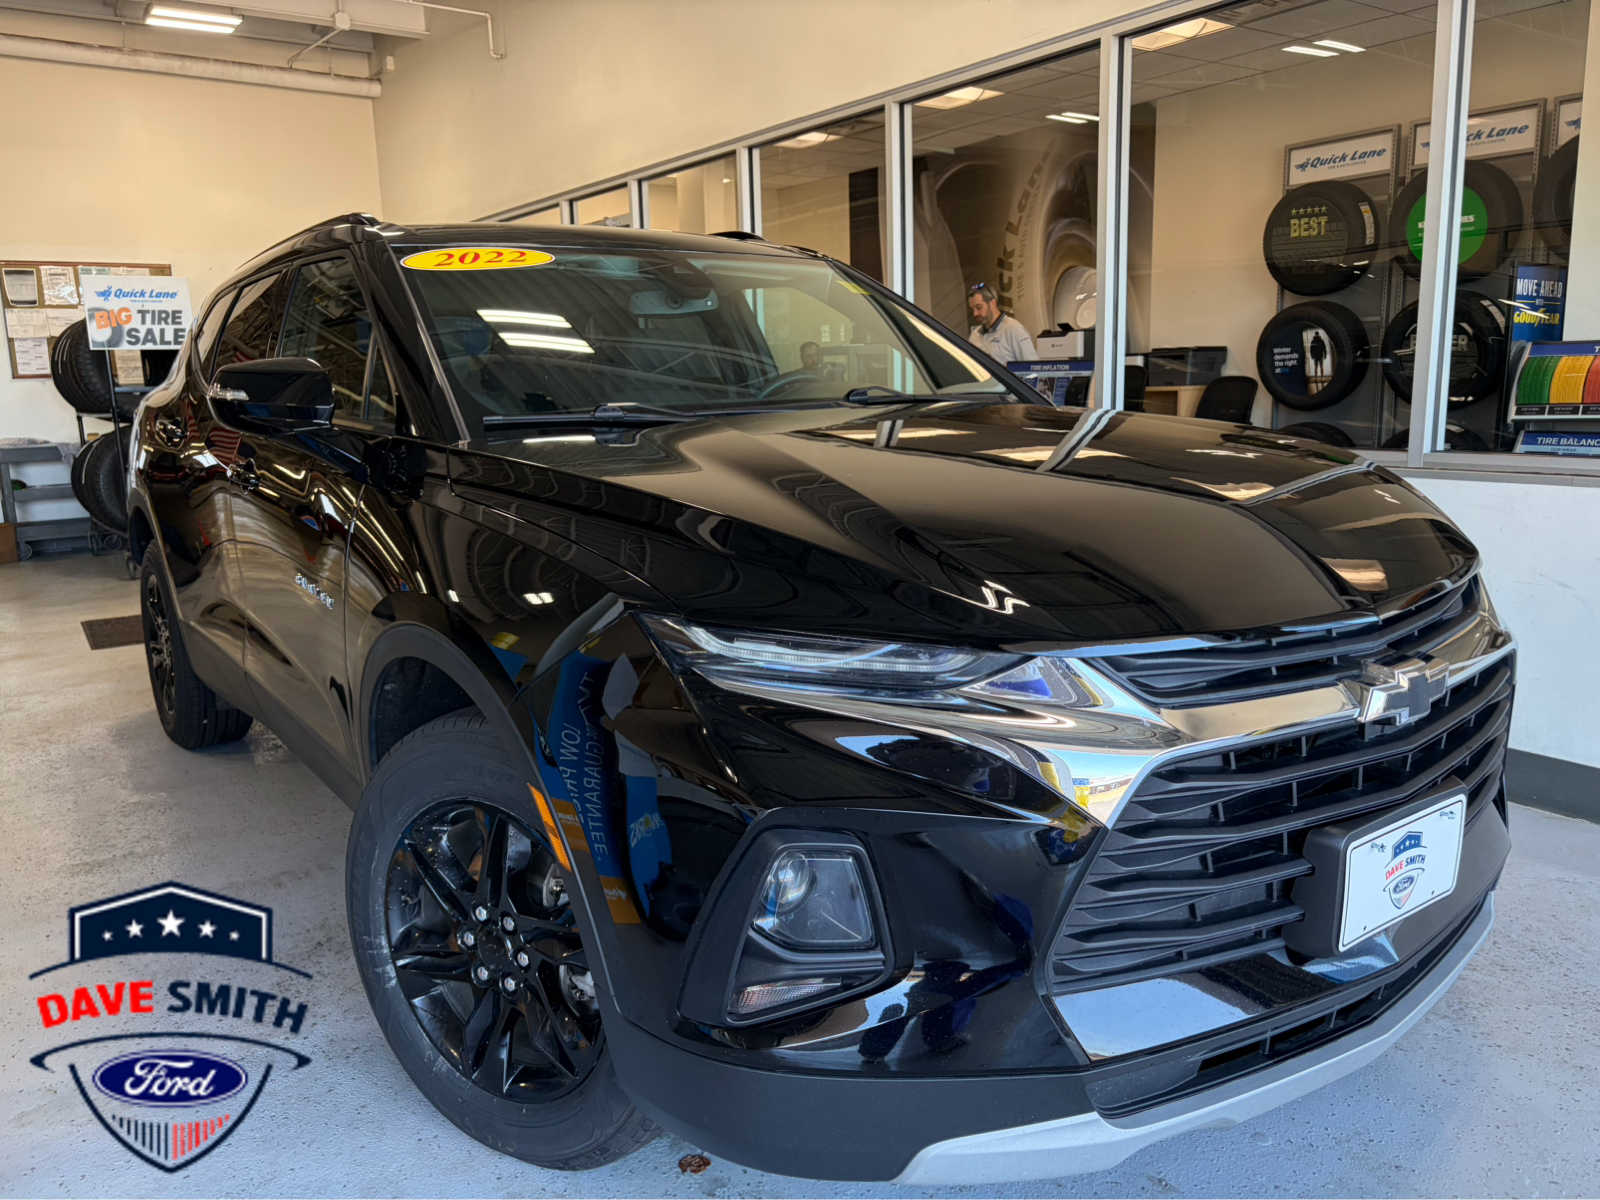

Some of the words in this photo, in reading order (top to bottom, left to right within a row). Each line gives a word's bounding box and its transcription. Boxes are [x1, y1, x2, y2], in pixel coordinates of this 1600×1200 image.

[1486, 123, 1529, 139] Lane
[1310, 152, 1349, 168] Quick
[1350, 148, 1387, 161] Lane
[1290, 216, 1328, 238] BEST
[434, 251, 527, 266] 2022
[114, 288, 148, 299] Quick
[149, 289, 178, 299] Lane
[1516, 279, 1538, 296] MOVE
[1540, 280, 1563, 298] AHEAD
[95, 307, 132, 330] BIG
[137, 310, 183, 325] TIRE
[126, 328, 187, 346] SALE
[1537, 436, 1560, 445] TIRE
[1385, 860, 1405, 880] DAVE
[1405, 854, 1426, 867] SMITH
